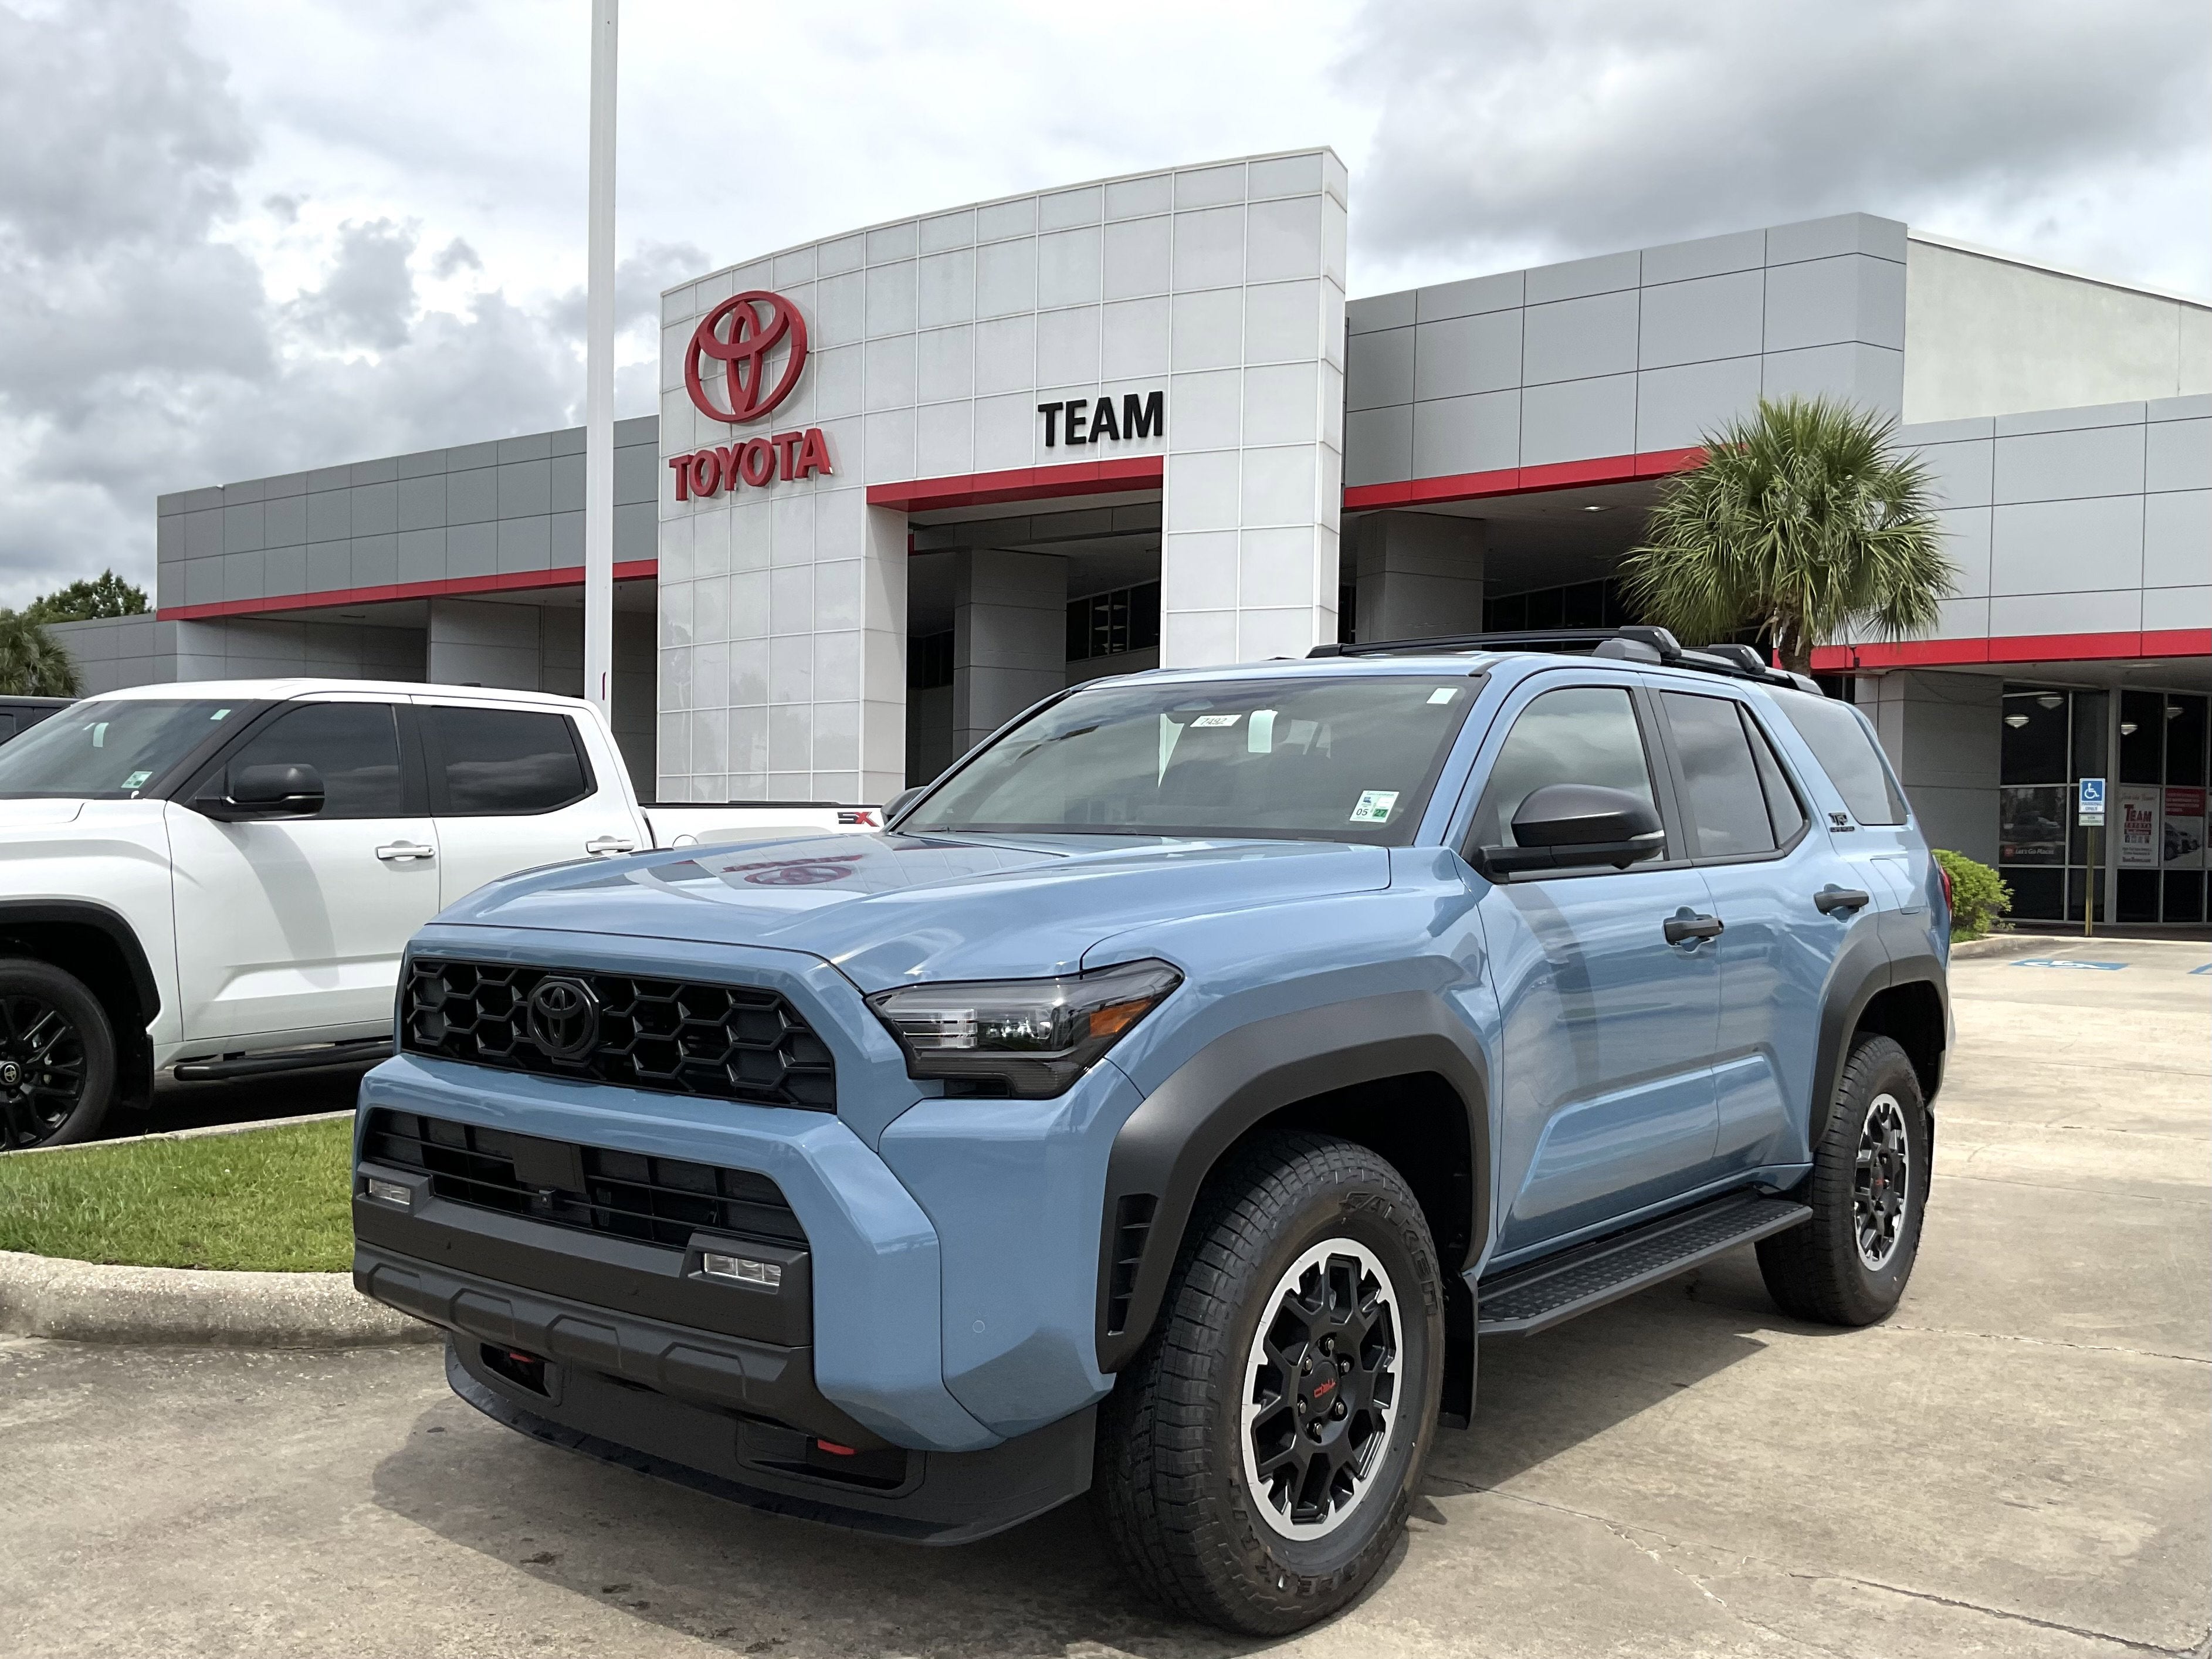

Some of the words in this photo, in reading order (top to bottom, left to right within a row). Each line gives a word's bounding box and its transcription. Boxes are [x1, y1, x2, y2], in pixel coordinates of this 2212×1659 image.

[1038, 391, 1163, 447] TEAM
[669, 428, 832, 501] TOYOTA
[837, 812, 880, 827] SX
[1374, 809, 1389, 817] 27
[1339, 1191, 1438, 1315] FALKEN
[1314, 1377, 1336, 1399] TRD
